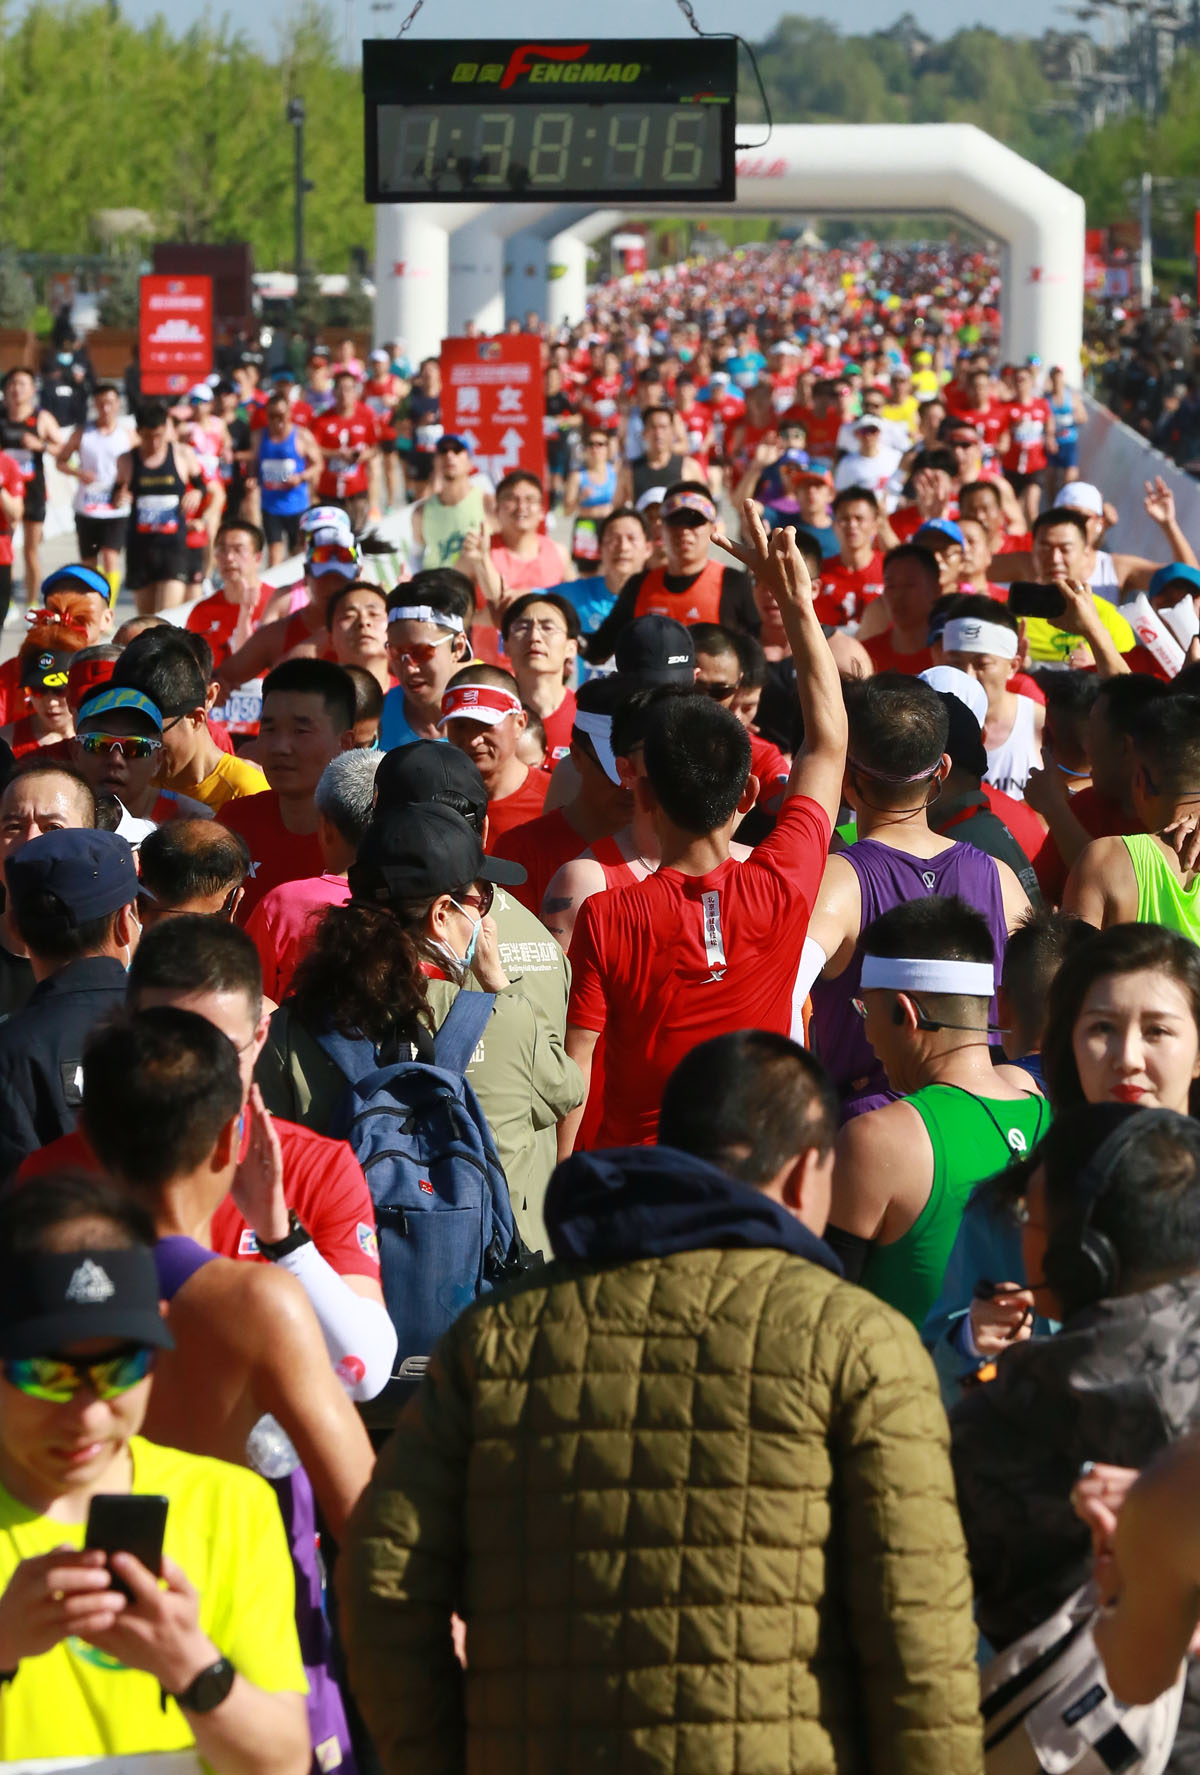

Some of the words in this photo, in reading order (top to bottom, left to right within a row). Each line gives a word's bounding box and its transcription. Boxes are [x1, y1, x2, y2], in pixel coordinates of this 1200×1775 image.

[500, 44, 642, 91] FENGMAO
[424, 112, 704, 183] 1:38:46
[498, 942, 559, 964] 京半程马拉松
